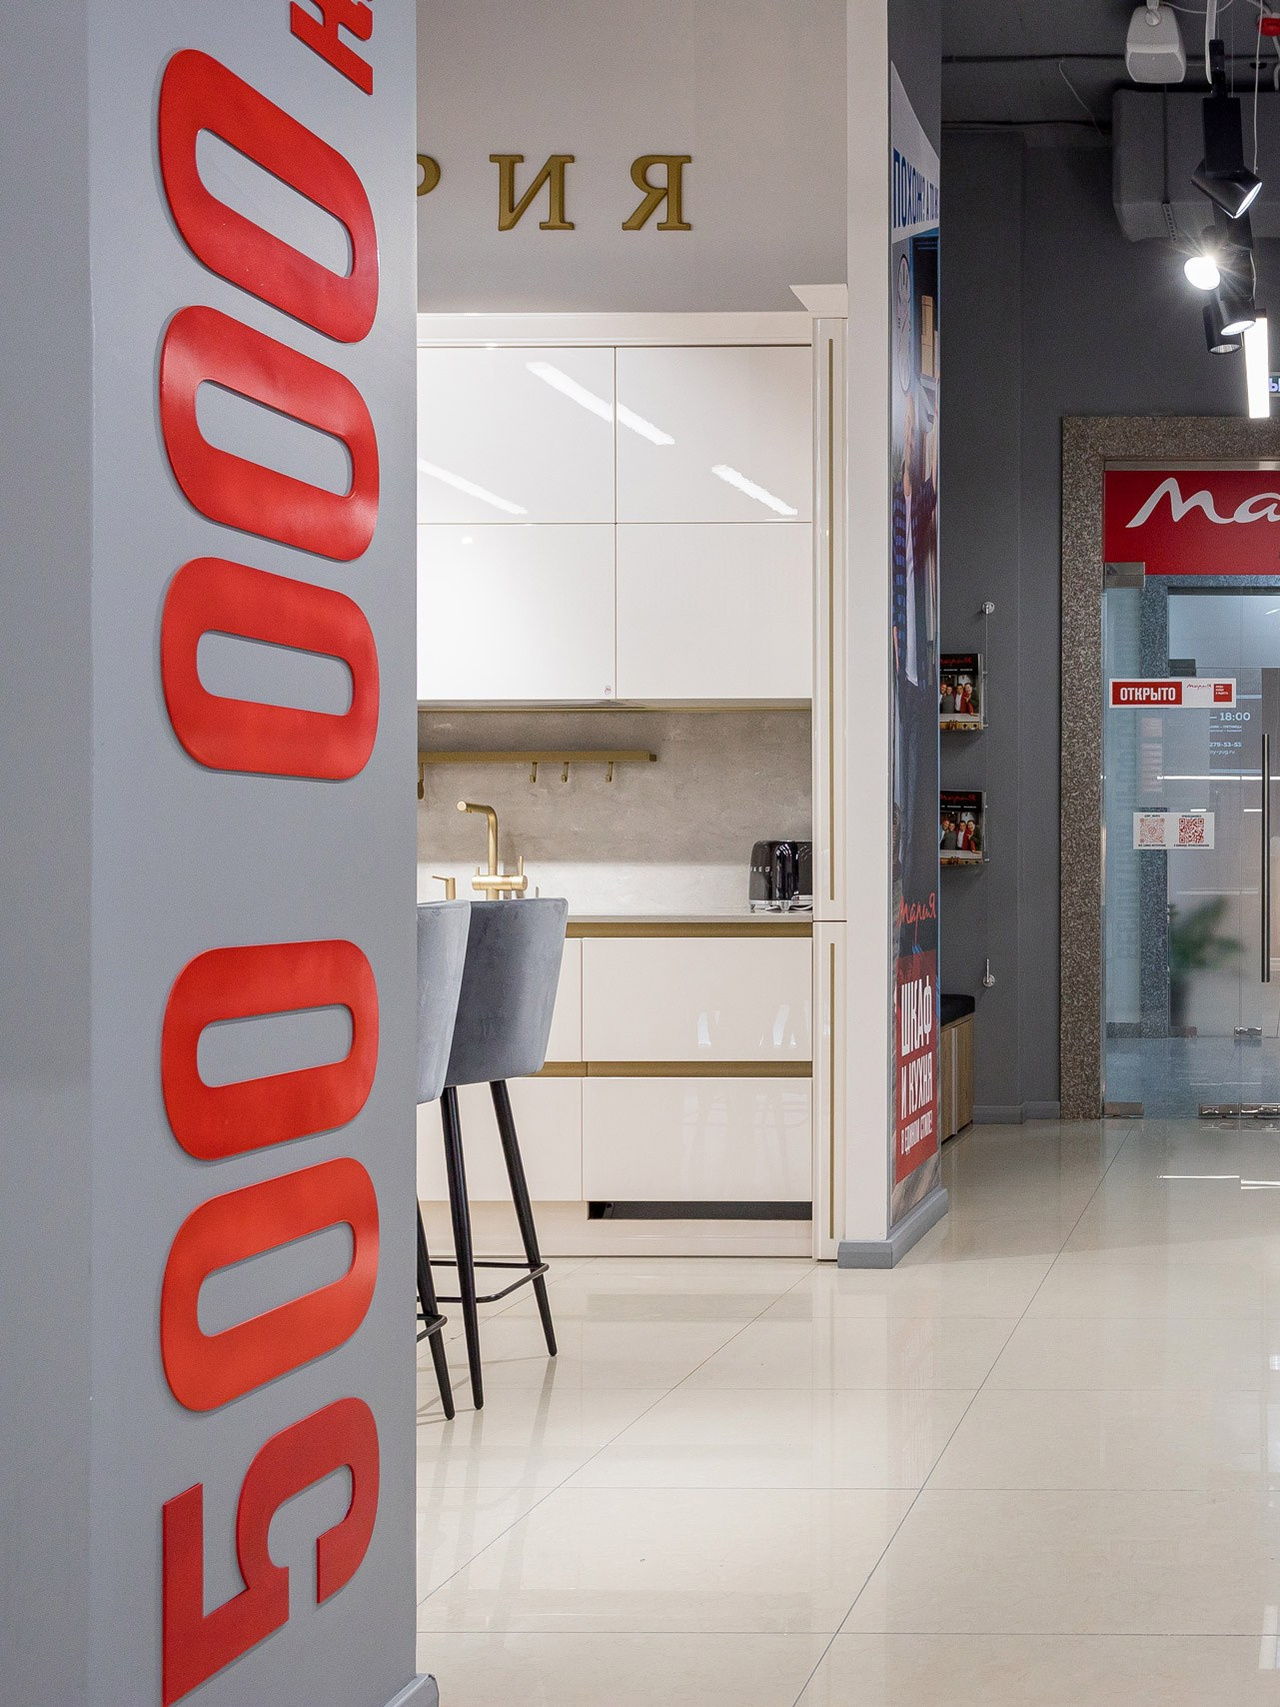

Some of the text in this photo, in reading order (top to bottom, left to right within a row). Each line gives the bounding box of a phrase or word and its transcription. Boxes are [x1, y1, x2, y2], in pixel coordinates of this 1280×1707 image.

[159, 49, 379, 780] 000
[1120, 687, 1176, 701] ОТКРЫТО
[1220, 712, 1250, 721] 18:00
[901, 975, 932, 1057] ШКАФ
[161, 939, 379, 1707] 500
